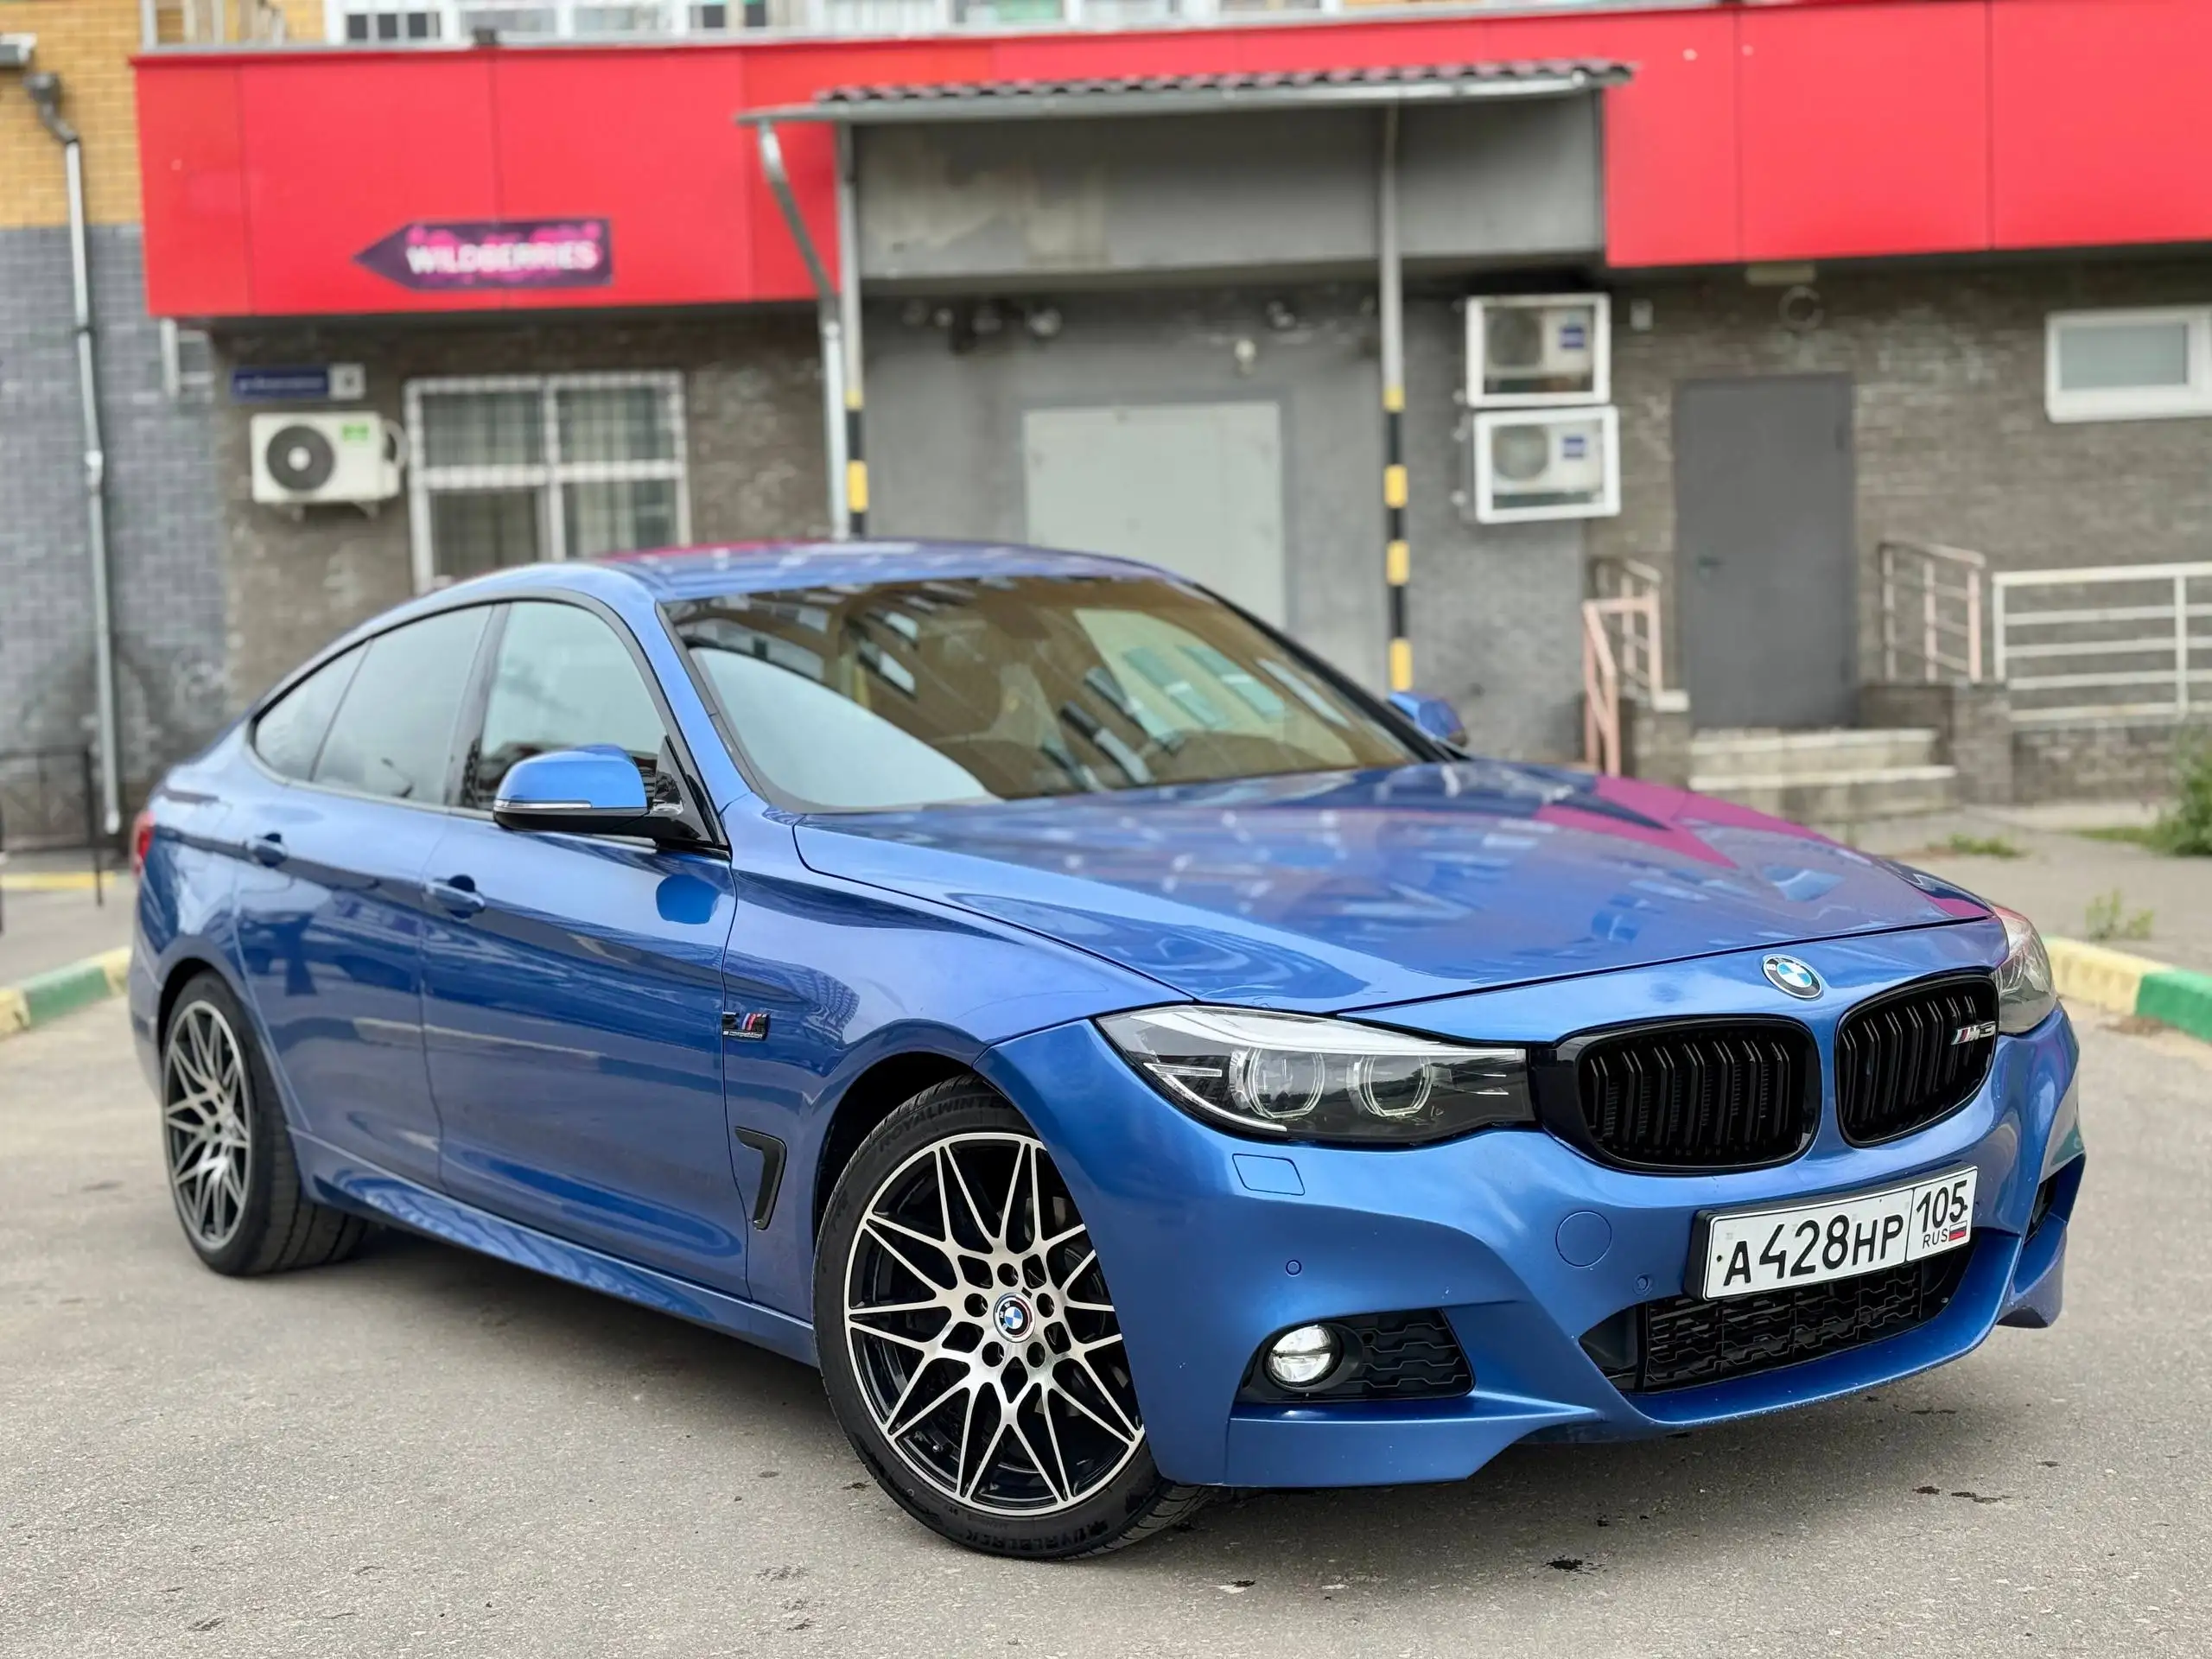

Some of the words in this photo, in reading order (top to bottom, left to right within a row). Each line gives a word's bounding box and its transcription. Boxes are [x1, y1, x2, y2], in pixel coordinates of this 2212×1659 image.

[405, 241, 600, 273] WILDBERRIES
[1916, 1179, 1968, 1233] 105
[1922, 1230, 1948, 1250] RUS
